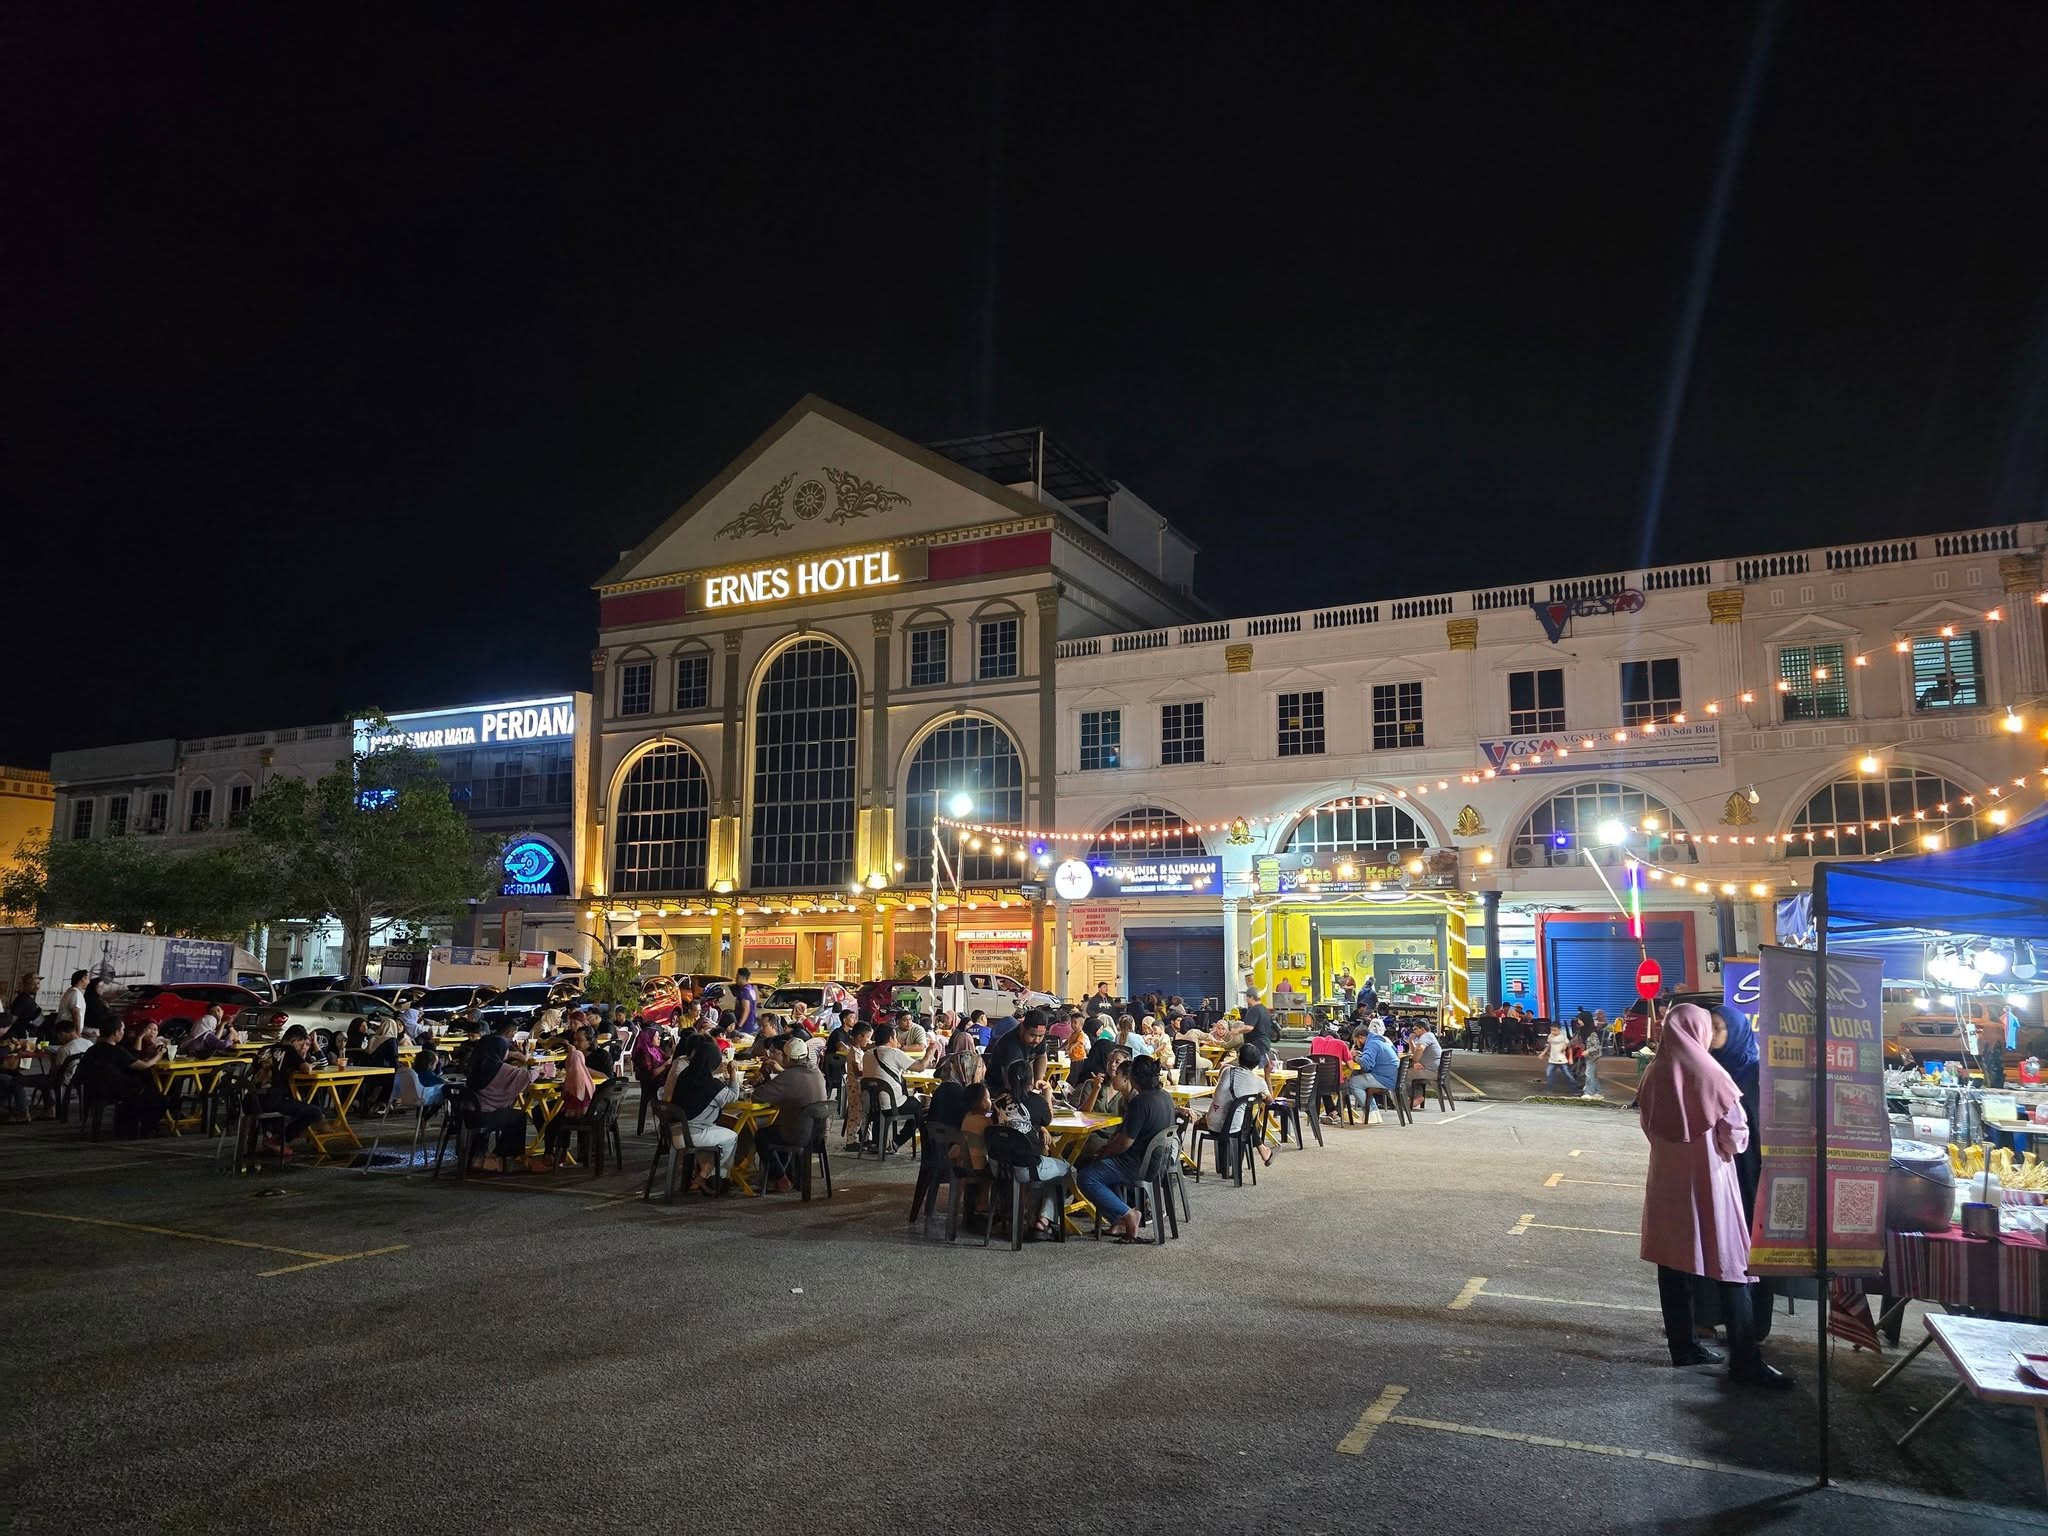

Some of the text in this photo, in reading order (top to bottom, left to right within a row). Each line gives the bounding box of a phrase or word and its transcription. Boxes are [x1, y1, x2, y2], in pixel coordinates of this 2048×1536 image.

[705, 550, 900, 609] ERNES HOTEL
[444, 727, 476, 746] MATA
[1562, 733, 1595, 744] VGSM
[1673, 727, 1692, 737] Sdn
[1695, 724, 1715, 735] Bhd
[1479, 738, 1560, 775] VGSM
[1159, 862, 1217, 875] RAUDHAH
[1302, 867, 1334, 883] Abe
[1365, 866, 1404, 882] Kafe
[768, 936, 794, 945] HOTEL
[171, 944, 223, 957] Sapphire
